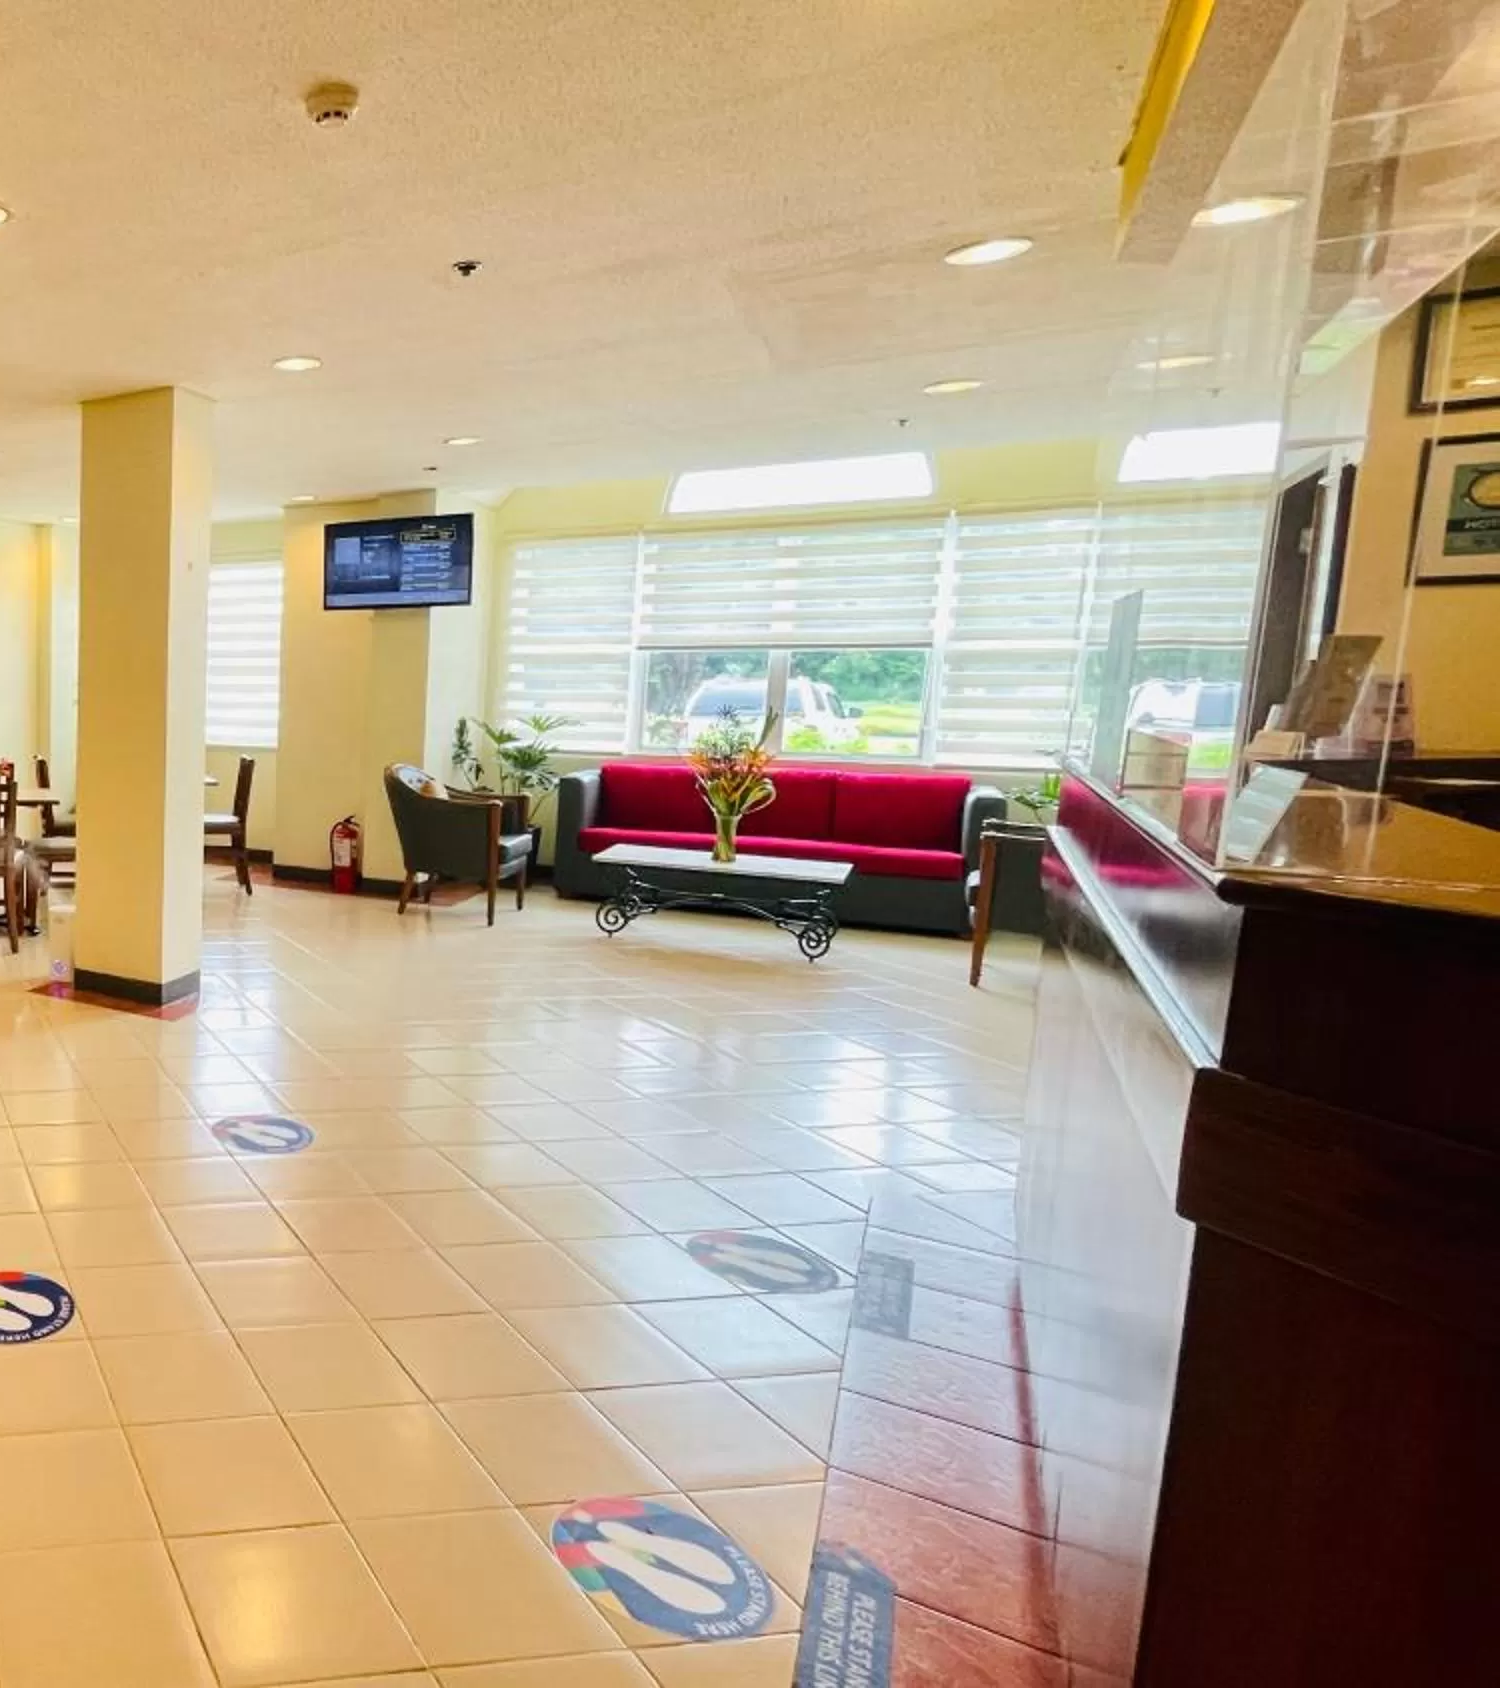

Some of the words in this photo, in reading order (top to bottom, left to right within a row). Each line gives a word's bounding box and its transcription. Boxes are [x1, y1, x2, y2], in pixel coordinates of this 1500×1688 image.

[737, 1591, 768, 1627] STAND
[821, 1571, 850, 1627] BEHIND
[849, 1591, 877, 1649] PLEASE
[816, 1627, 844, 1666] THIS
